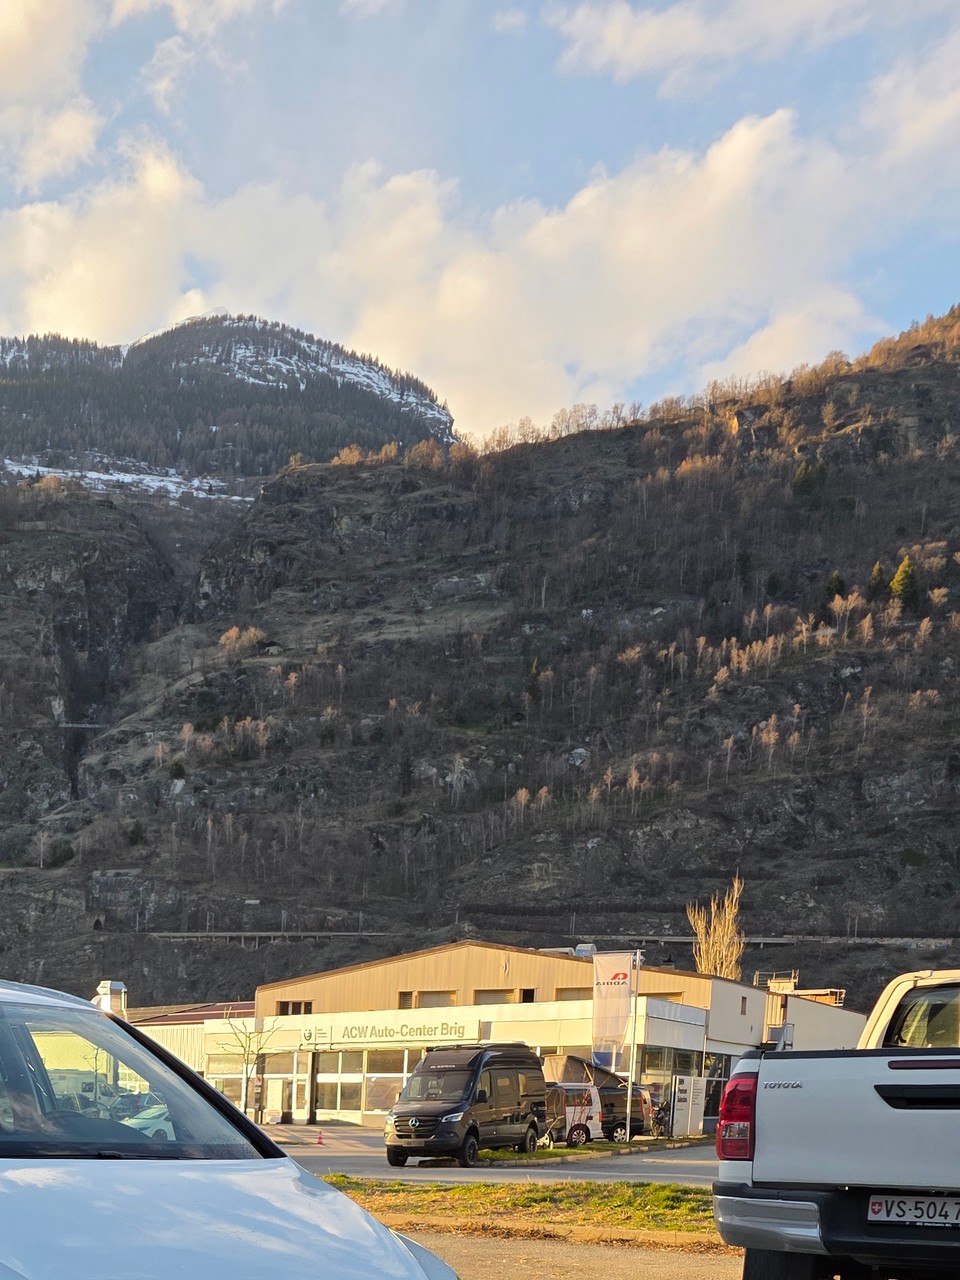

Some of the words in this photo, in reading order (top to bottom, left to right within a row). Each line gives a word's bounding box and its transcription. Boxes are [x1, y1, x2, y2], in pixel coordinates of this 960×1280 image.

[342, 1025, 369, 1039] ACW
[370, 1024, 438, 1038] Auto-Center
[440, 1022, 465, 1038] Brig
[763, 1081, 802, 1089] TOYOTA
